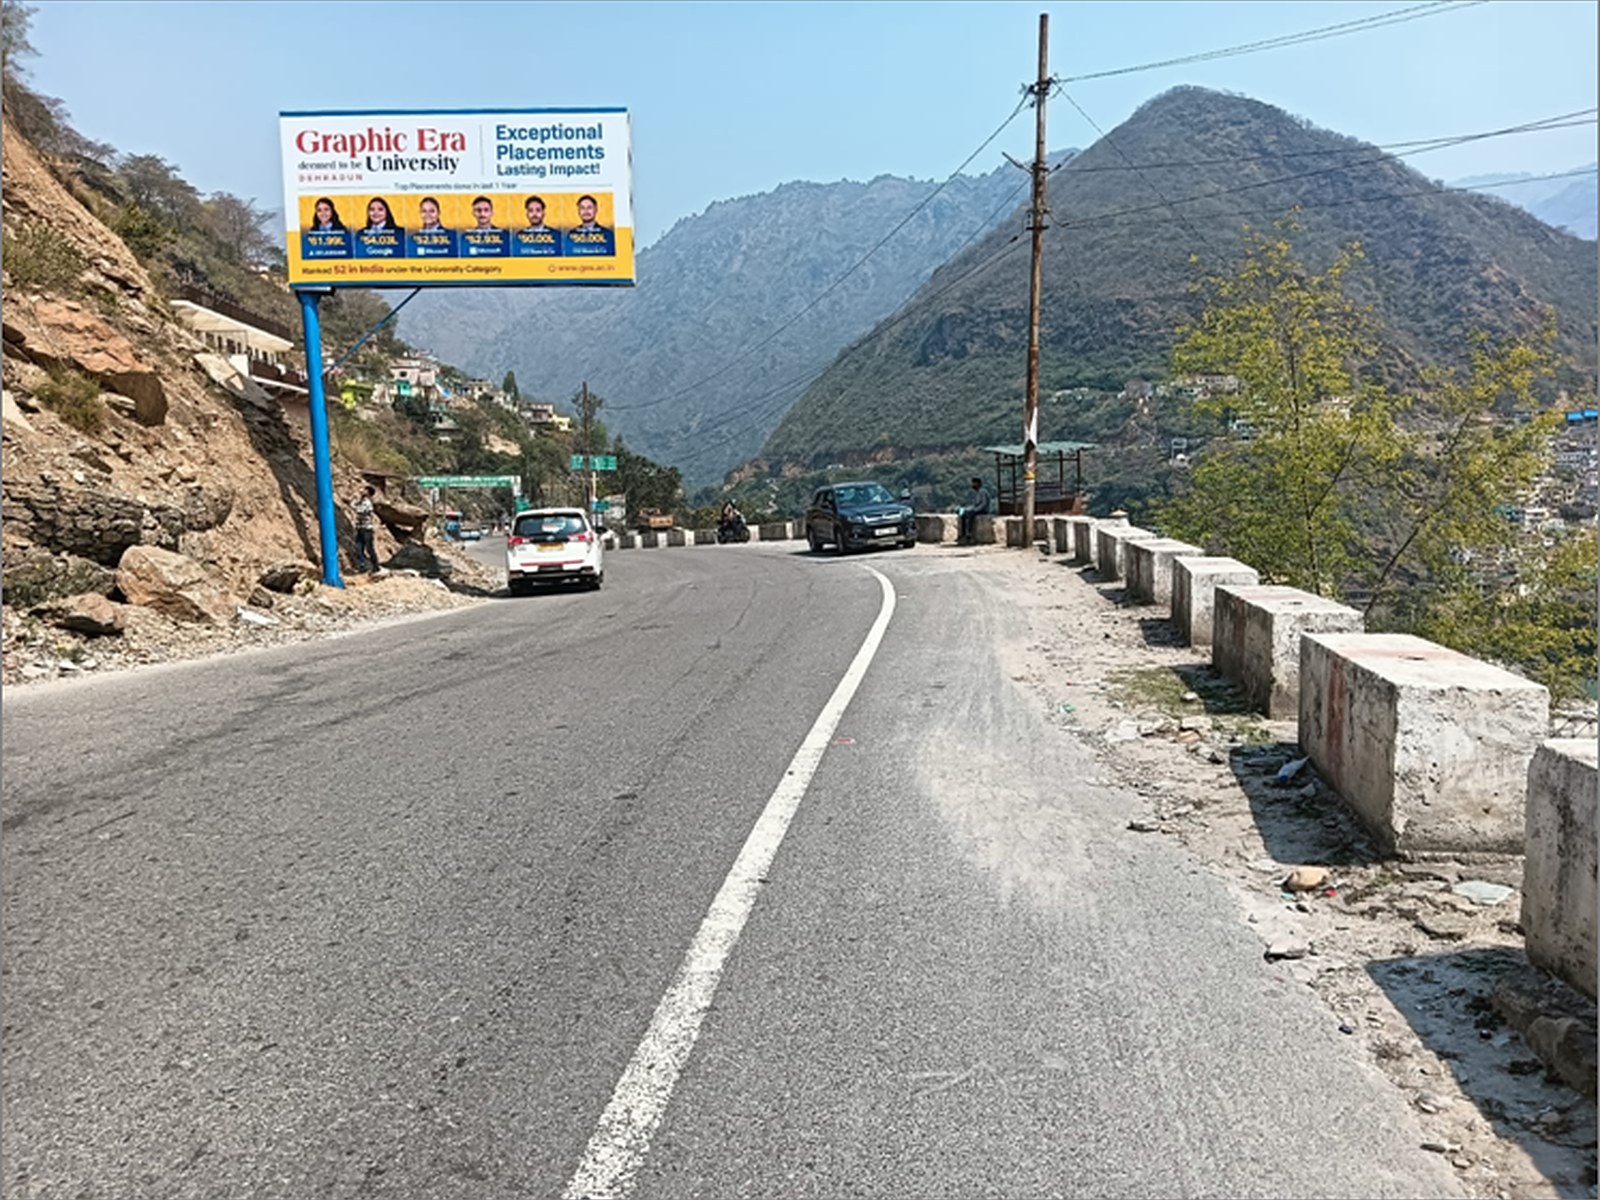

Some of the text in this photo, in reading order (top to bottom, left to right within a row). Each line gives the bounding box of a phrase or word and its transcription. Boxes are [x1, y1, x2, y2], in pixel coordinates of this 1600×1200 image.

[496, 123, 603, 143] Exceptional
[295, 127, 466, 158] Graphic Era
[496, 144, 605, 161] Placements
[298, 153, 459, 175] deemed to be University
[497, 162, 600, 178] Lasting Impact!
[366, 246, 394, 256] Google
[360, 264, 384, 273] India
